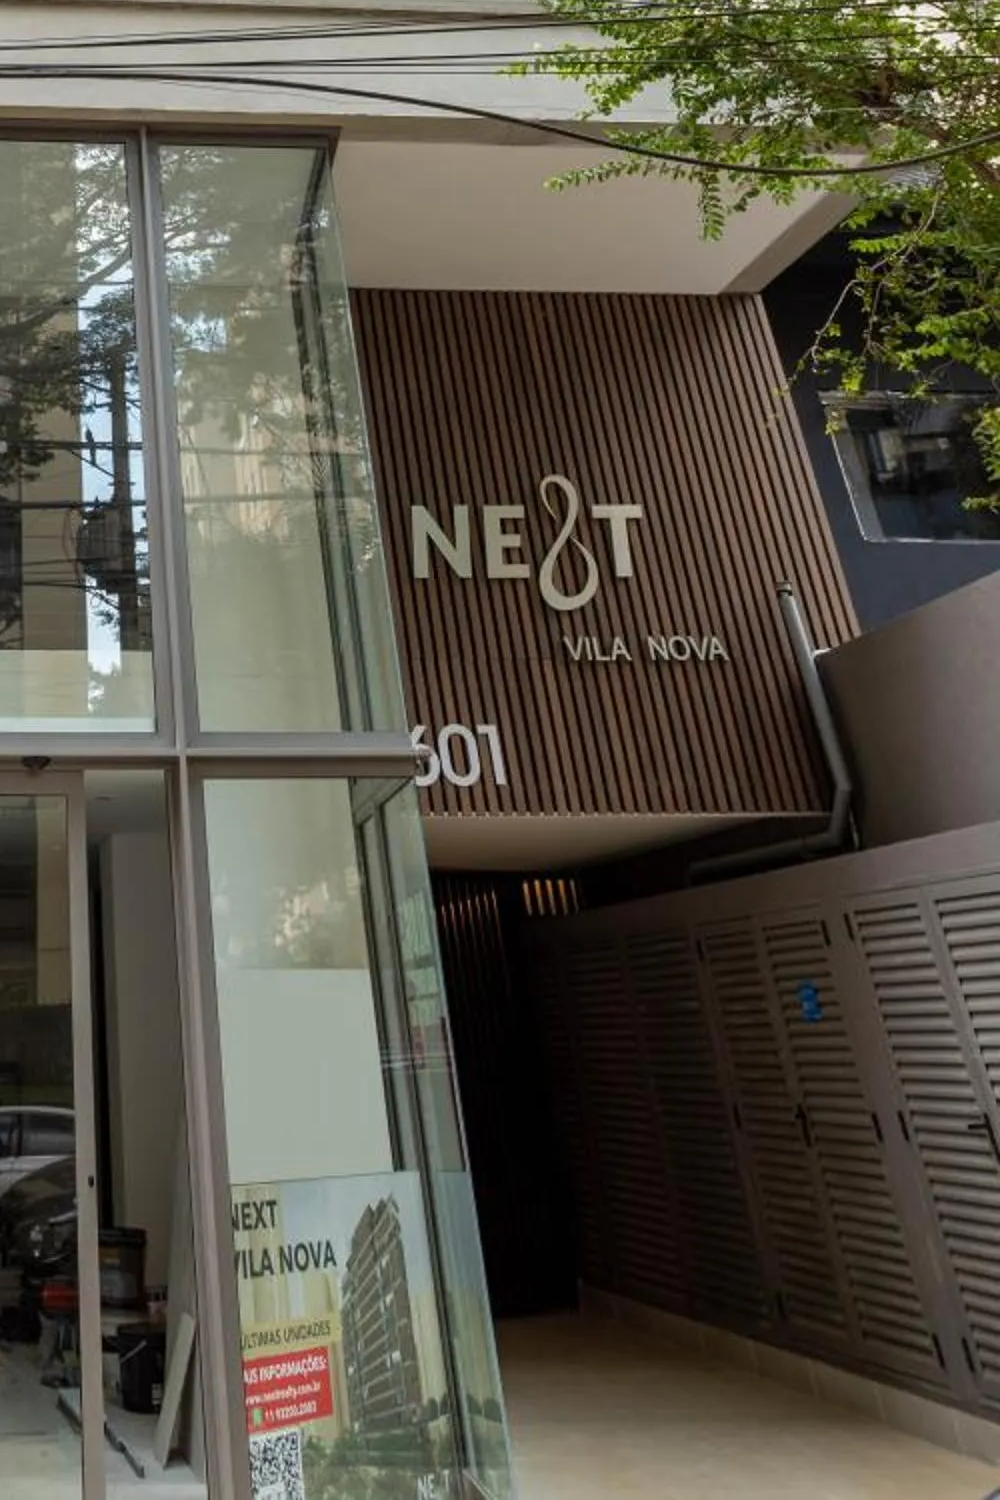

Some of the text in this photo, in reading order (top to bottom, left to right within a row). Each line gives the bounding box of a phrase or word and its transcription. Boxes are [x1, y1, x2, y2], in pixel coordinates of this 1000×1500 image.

[563, 635, 730, 661] VILA NOVA
[411, 723, 507, 787] 601
[279, 1240, 337, 1274] NOVA
